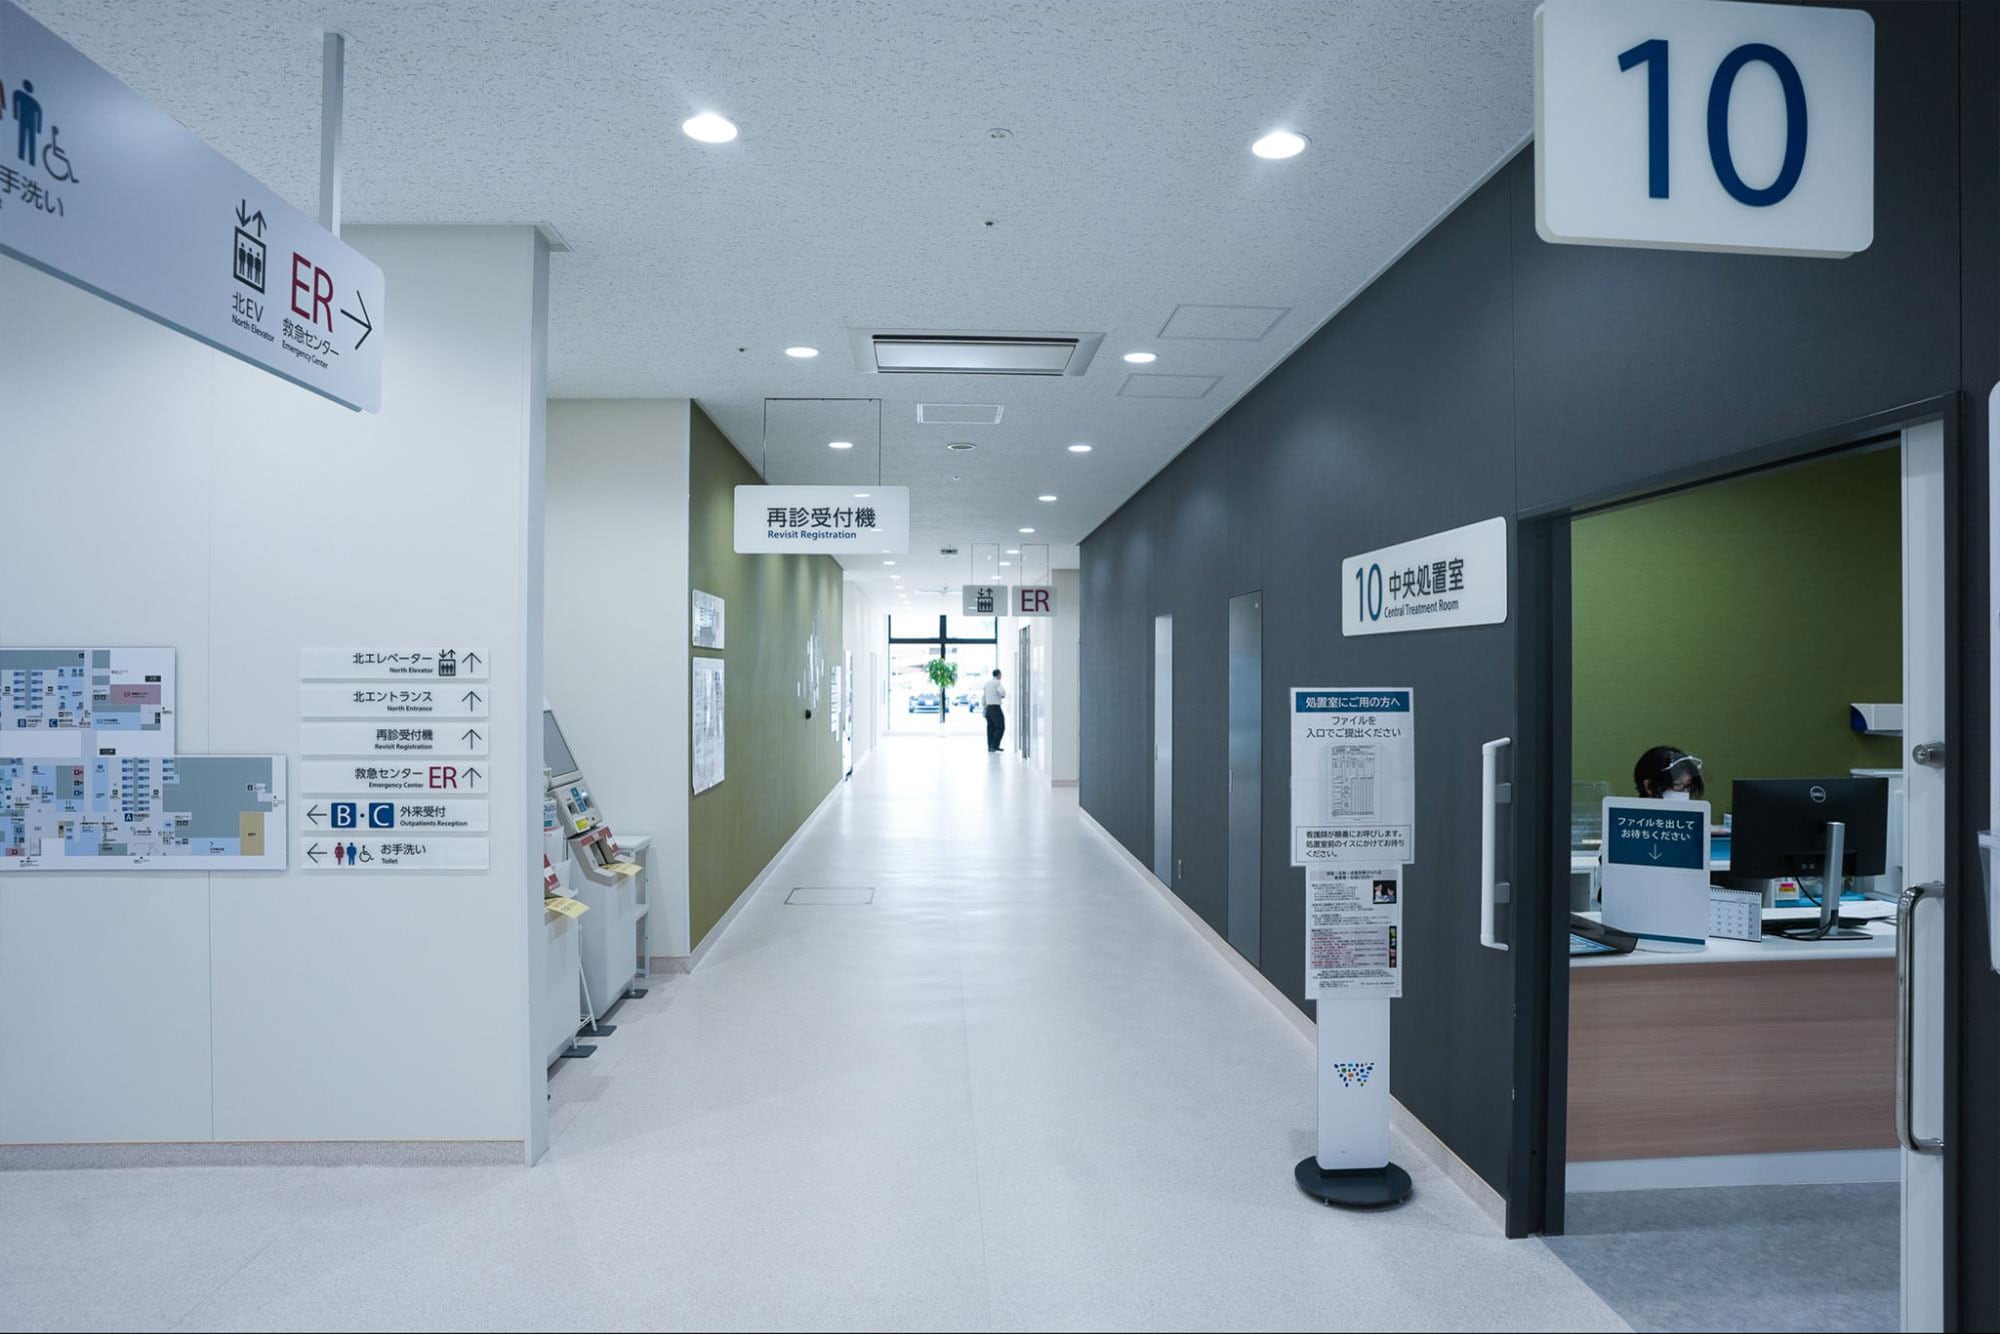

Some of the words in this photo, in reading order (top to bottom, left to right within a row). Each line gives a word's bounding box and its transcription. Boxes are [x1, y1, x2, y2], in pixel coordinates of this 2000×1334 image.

[1617, 38, 1808, 207] 10
[291, 252, 333, 333] ER
[232, 291, 264, 322] 北EV
[231, 314, 251, 331] North
[251, 323, 275, 343] Elevator
[282, 317, 339, 356] 救急センター
[281, 339, 312, 362] Emergency
[312, 354, 329, 369] Center
[767, 507, 876, 528] 再診受付機
[767, 530, 799, 539] Revisit
[800, 530, 857, 541] Registration
[1356, 563, 1383, 622] 10
[1389, 557, 1465, 600] 中央処置室
[1021, 589, 1050, 612] ER
[1384, 605, 1404, 619] Central
[1405, 602, 1438, 616] Treatment
[1438, 599, 1459, 611] Room
[353, 653, 433, 665] 北エレベーター
[353, 691, 433, 703] 北エントランス
[1305, 697, 1401, 709] 処置室にご用の方へ
[1331, 716, 1377, 726] ファイルを
[376, 729, 433, 741] 再診受付機
[1306, 727, 1401, 739] 入口でご提出ください
[396, 743, 433, 751] Registration
[355, 768, 423, 780] 救急センター
[429, 766, 458, 789] ER
[368, 782, 402, 790] Emergency
[400, 806, 446, 818] 外来受付
[399, 820, 436, 828] Outpatients
[437, 820, 468, 828] Reception
[1617, 817, 1695, 830] ファイルを出して
[1621, 829, 1691, 841] お待ちください
[380, 844, 426, 855] お手洗い
[1306, 850, 1338, 858] ください。
